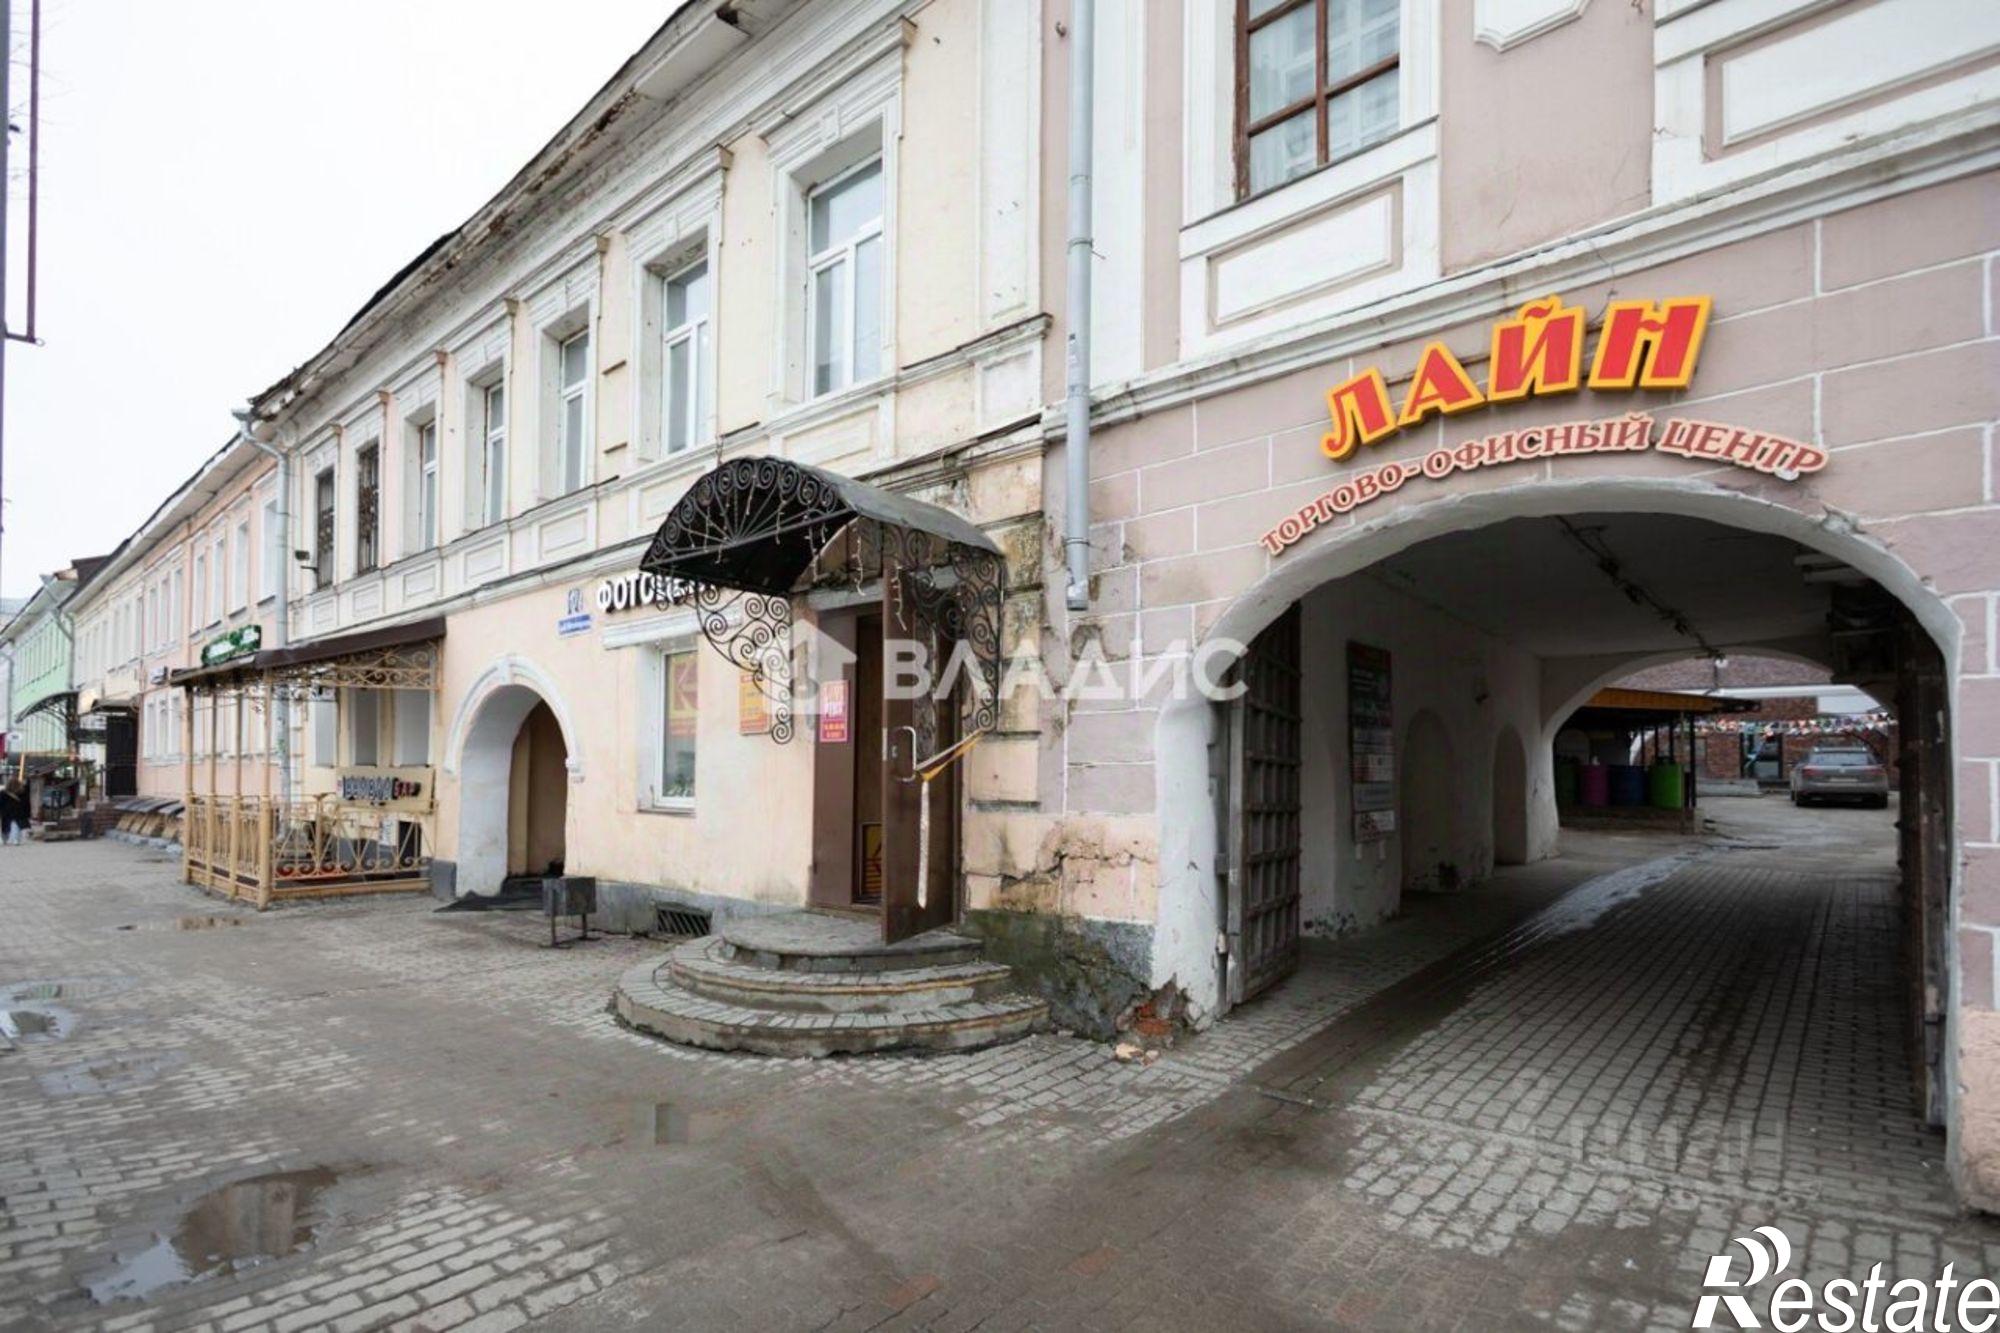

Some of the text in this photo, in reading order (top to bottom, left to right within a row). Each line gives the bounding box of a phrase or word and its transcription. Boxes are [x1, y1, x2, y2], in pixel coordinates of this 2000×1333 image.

[1320, 296, 1712, 462] ЛАЙН
[1259, 411, 1829, 557] ТОРГОВО-ОФИСНЫЙ ЦЕНТР
